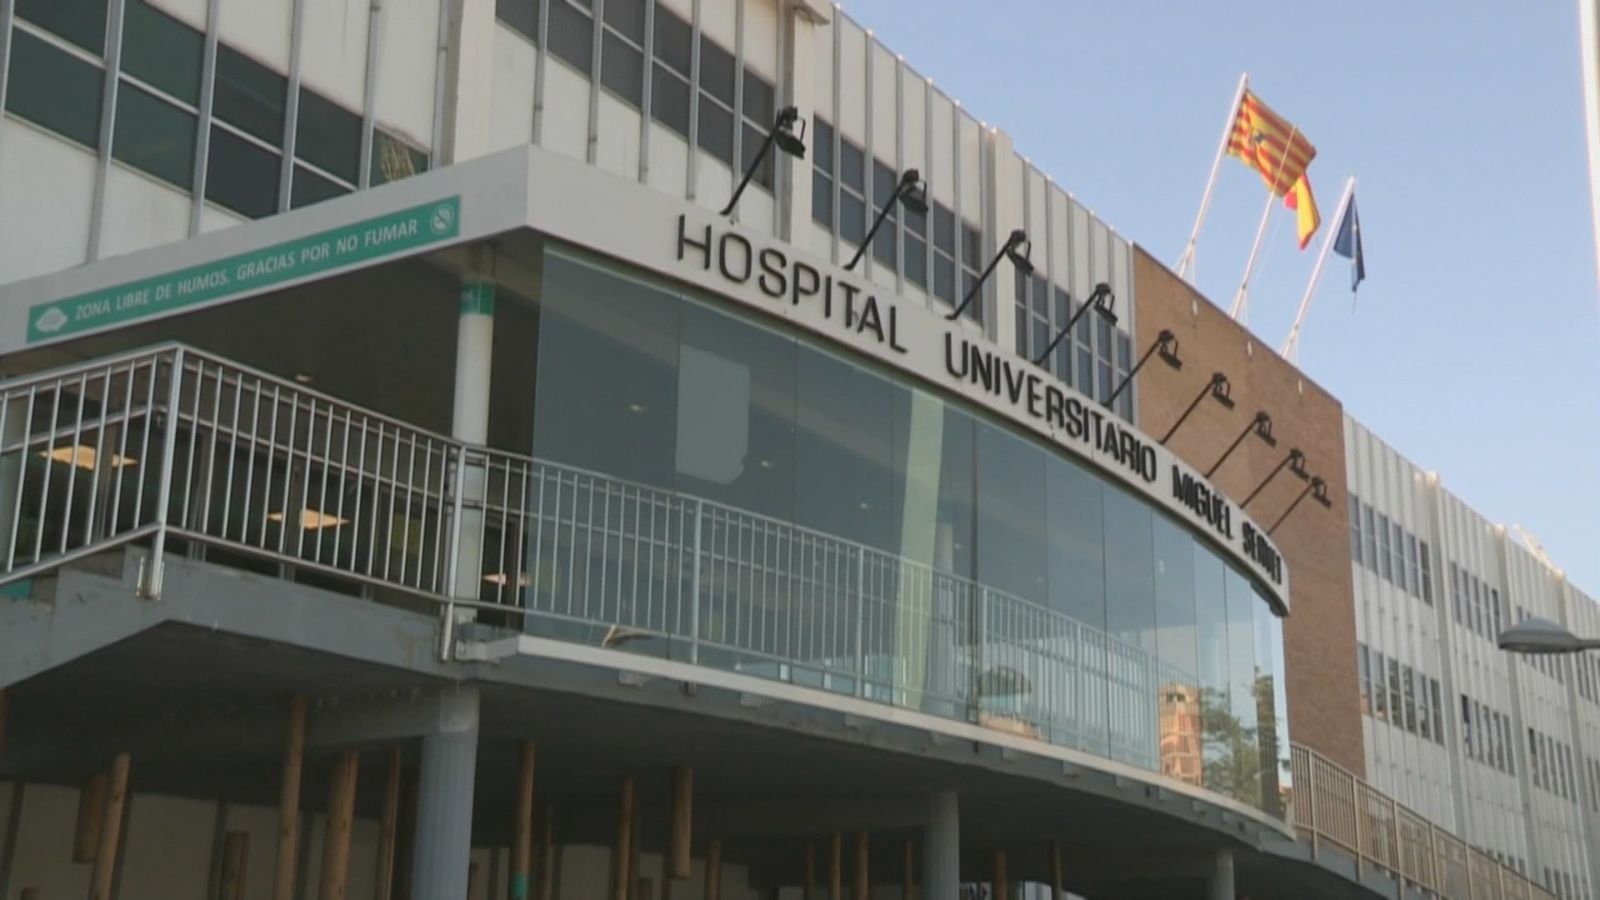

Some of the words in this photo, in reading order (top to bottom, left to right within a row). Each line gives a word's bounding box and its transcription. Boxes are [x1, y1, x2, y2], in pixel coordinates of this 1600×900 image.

[76, 302, 111, 321] ZONA
[116, 290, 150, 311] LIBRE
[155, 283, 174, 301] DE
[177, 269, 231, 295] HUMOS.
[236, 253, 296, 281] GRACIAS
[301, 243, 331, 264] POR
[336, 234, 359, 254] NO
[364, 219, 418, 248] FUMAR
[677, 214, 909, 353] HOSPITAL
[945, 332, 1157, 483] UNIVERSITARIO
[1172, 465, 1234, 540] MIGUEL
[1242, 521, 1282, 585] SET
